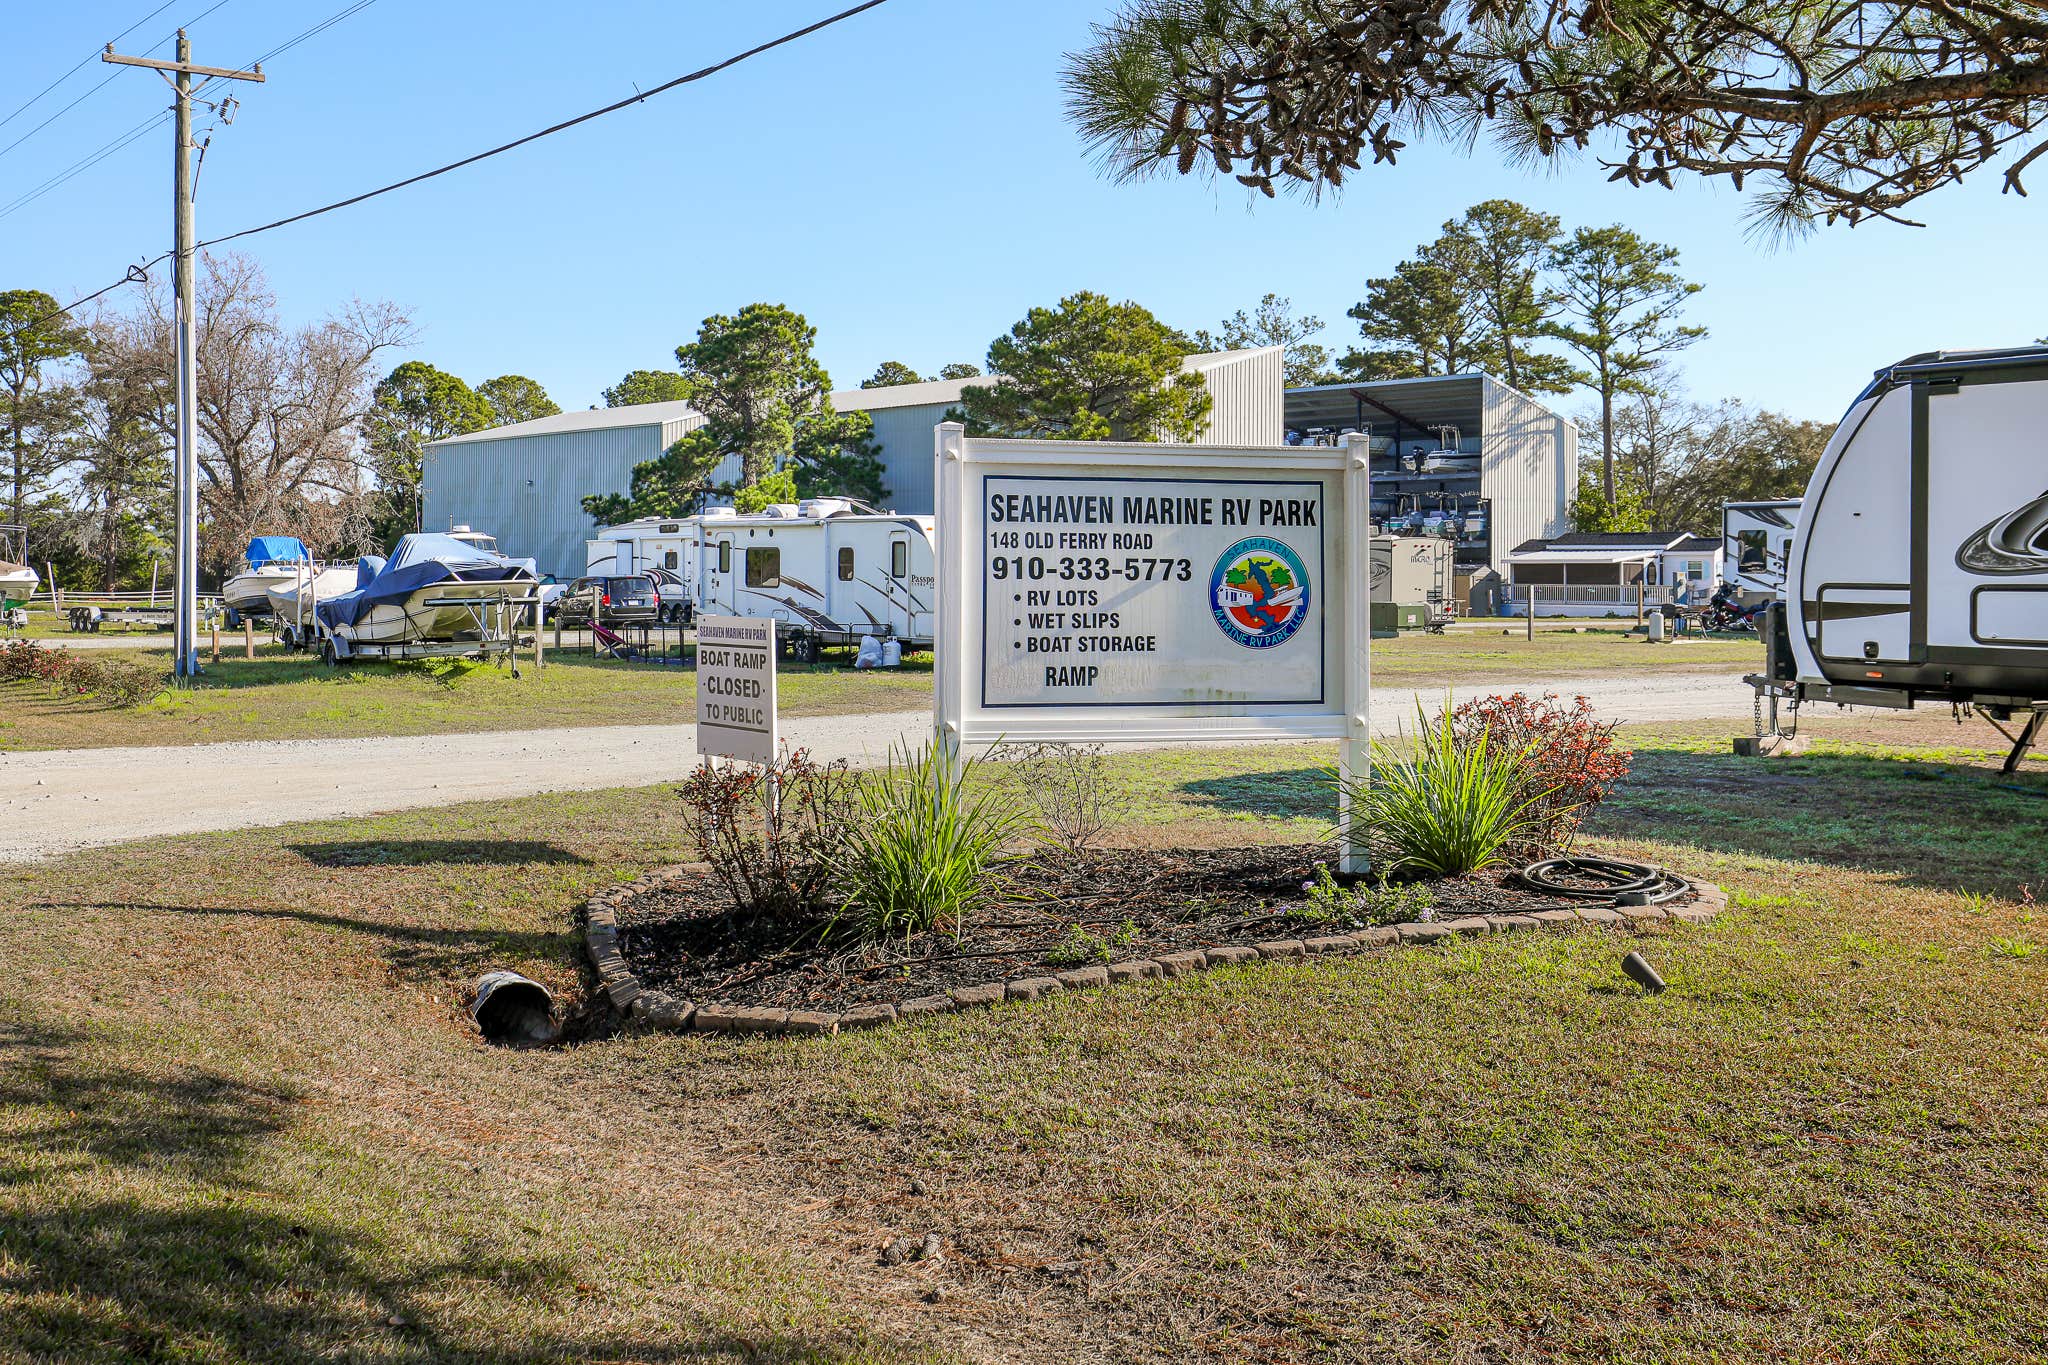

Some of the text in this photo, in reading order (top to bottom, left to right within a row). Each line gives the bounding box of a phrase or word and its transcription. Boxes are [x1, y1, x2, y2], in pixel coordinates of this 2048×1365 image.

[991, 494, 1317, 526] SEAHAVEN MARINE RV PARK
[991, 532, 1153, 550] 148 OLD FERRY ROAD
[1226, 538, 1292, 560] SEAHAVEN
[992, 556, 1192, 581] 910-333-5773
[911, 574, 934, 585] Passpo
[1027, 590, 1098, 606] RV LOTS
[1028, 612, 1120, 629] WET SLIPS
[1214, 609, 1248, 645] MARINE
[1249, 635, 1263, 647] RV
[1290, 608, 1304, 629] LLC
[700, 626, 767, 640] SEAHAVEN MARINE RV PARK
[1027, 636, 1156, 652] BOAT STORAGE
[701, 650, 766, 670] BOAT RAMP
[707, 675, 760, 698] CLOSED
[1045, 666, 1099, 687] RAMP
[706, 703, 763, 725] TO PUBLIC
